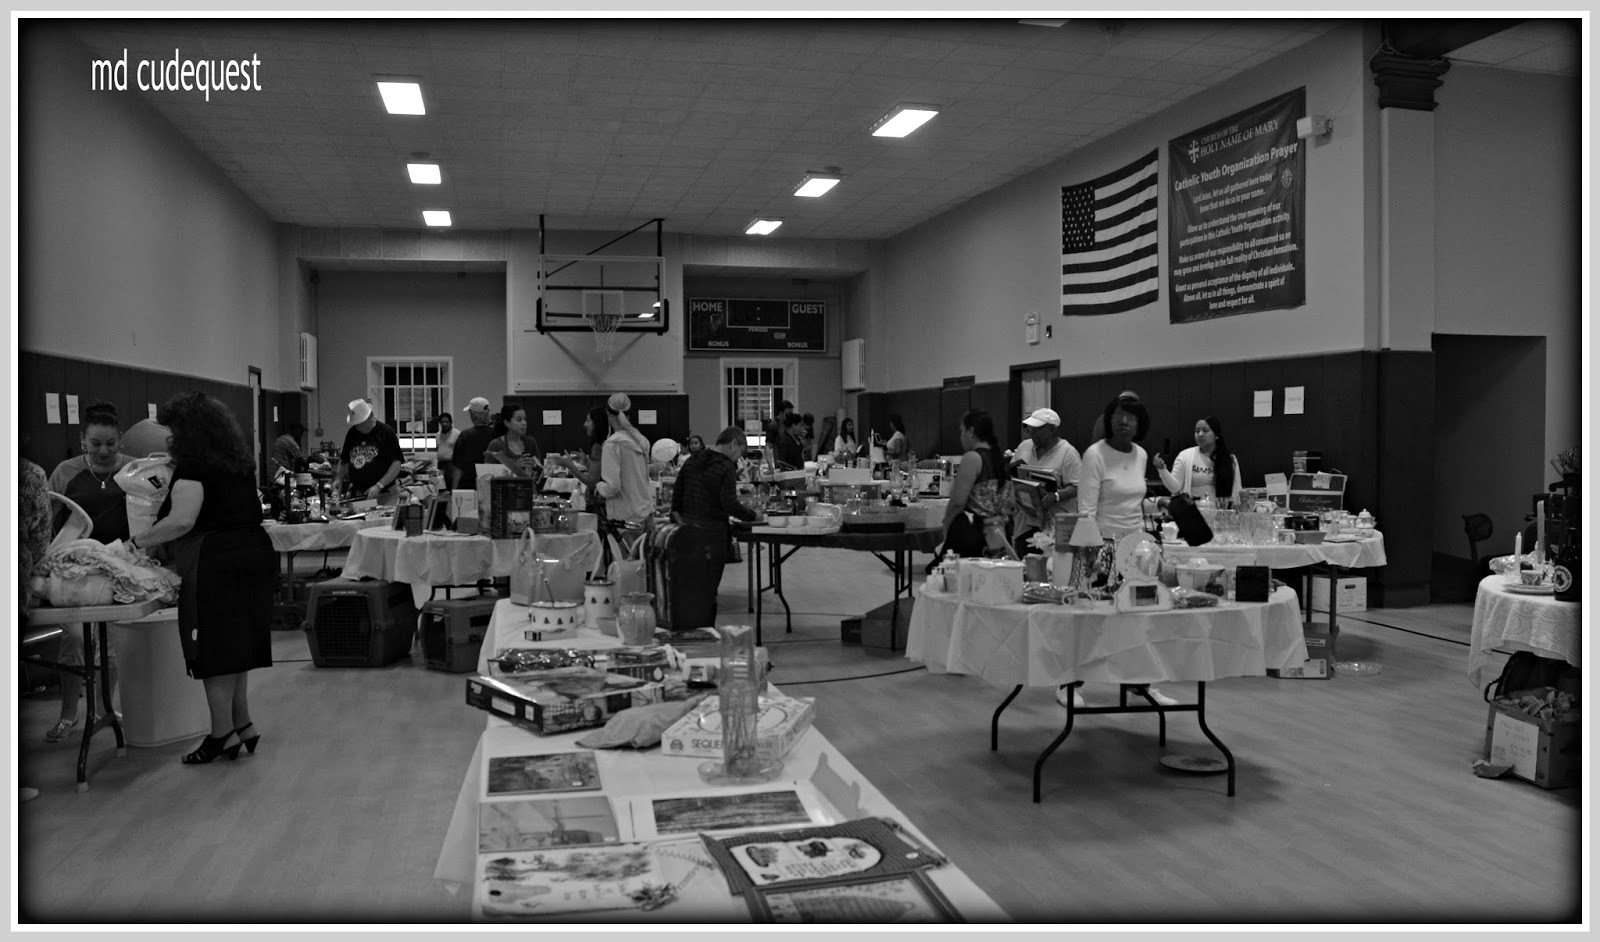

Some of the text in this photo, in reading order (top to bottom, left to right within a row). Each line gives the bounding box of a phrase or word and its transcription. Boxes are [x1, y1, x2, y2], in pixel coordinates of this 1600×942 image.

[1200, 118, 1280, 157] HOLY NAME OF MARY
[1201, 124, 1239, 145] CHURCH OF THE
[1175, 142, 1298, 191] Catholic Youth Organization Prayer
[1249, 177, 1259, 186] here
[1259, 172, 1273, 183] today
[1210, 201, 1218, 210] that
[1225, 197, 1230, 206] do
[1236, 194, 1240, 202] in
[1240, 192, 1250, 203] your
[1251, 188, 1266, 198] name.
[1208, 214, 1230, 228] understand
[1238, 211, 1246, 220] true
[1247, 206, 1266, 218] meaning
[1267, 202, 1272, 213] of
[1272, 202, 1281, 211] our
[1179, 235, 1203, 249] participation
[1203, 233, 1208, 241] in
[1216, 226, 1231, 238] Catholic
[1231, 223, 1243, 234] Youth
[1243, 217, 1272, 232] Organization
[1173, 269, 1182, 277] may
[1200, 261, 1214, 270] develop
[1214, 259, 1219, 268] in
[1234, 253, 1247, 263] reality
[1248, 250, 1253, 260] of
[1253, 248, 1273, 259] Christian
[1273, 242, 1299, 255] formation.
[1179, 254, 1189, 264] Make
[1205, 248, 1210, 258] of
[1217, 242, 1244, 256] responsibility
[1256, 232, 1279, 246] concerned
[1175, 284, 1186, 292] Grant
[1191, 278, 1207, 292] personal
[1208, 276, 1228, 287] acceptance
[1229, 273, 1234, 282] of
[1242, 270, 1257, 282] dignity
[1258, 267, 1263, 277] of
[1269, 261, 1295, 274] individuals.
[1183, 294, 1195, 302] Above
[1212, 289, 1216, 297] in
[1222, 286, 1236, 296] things,
[1236, 281, 1264, 293] demonstrate
[1268, 277, 1280, 290] spirit
[1280, 276, 1285, 286] of
[692, 302, 723, 312] HOME
[792, 304, 824, 314] GUEST
[1209, 301, 1218, 310] love
[1218, 299, 1226, 308] and
[1226, 297, 1241, 308] respect
